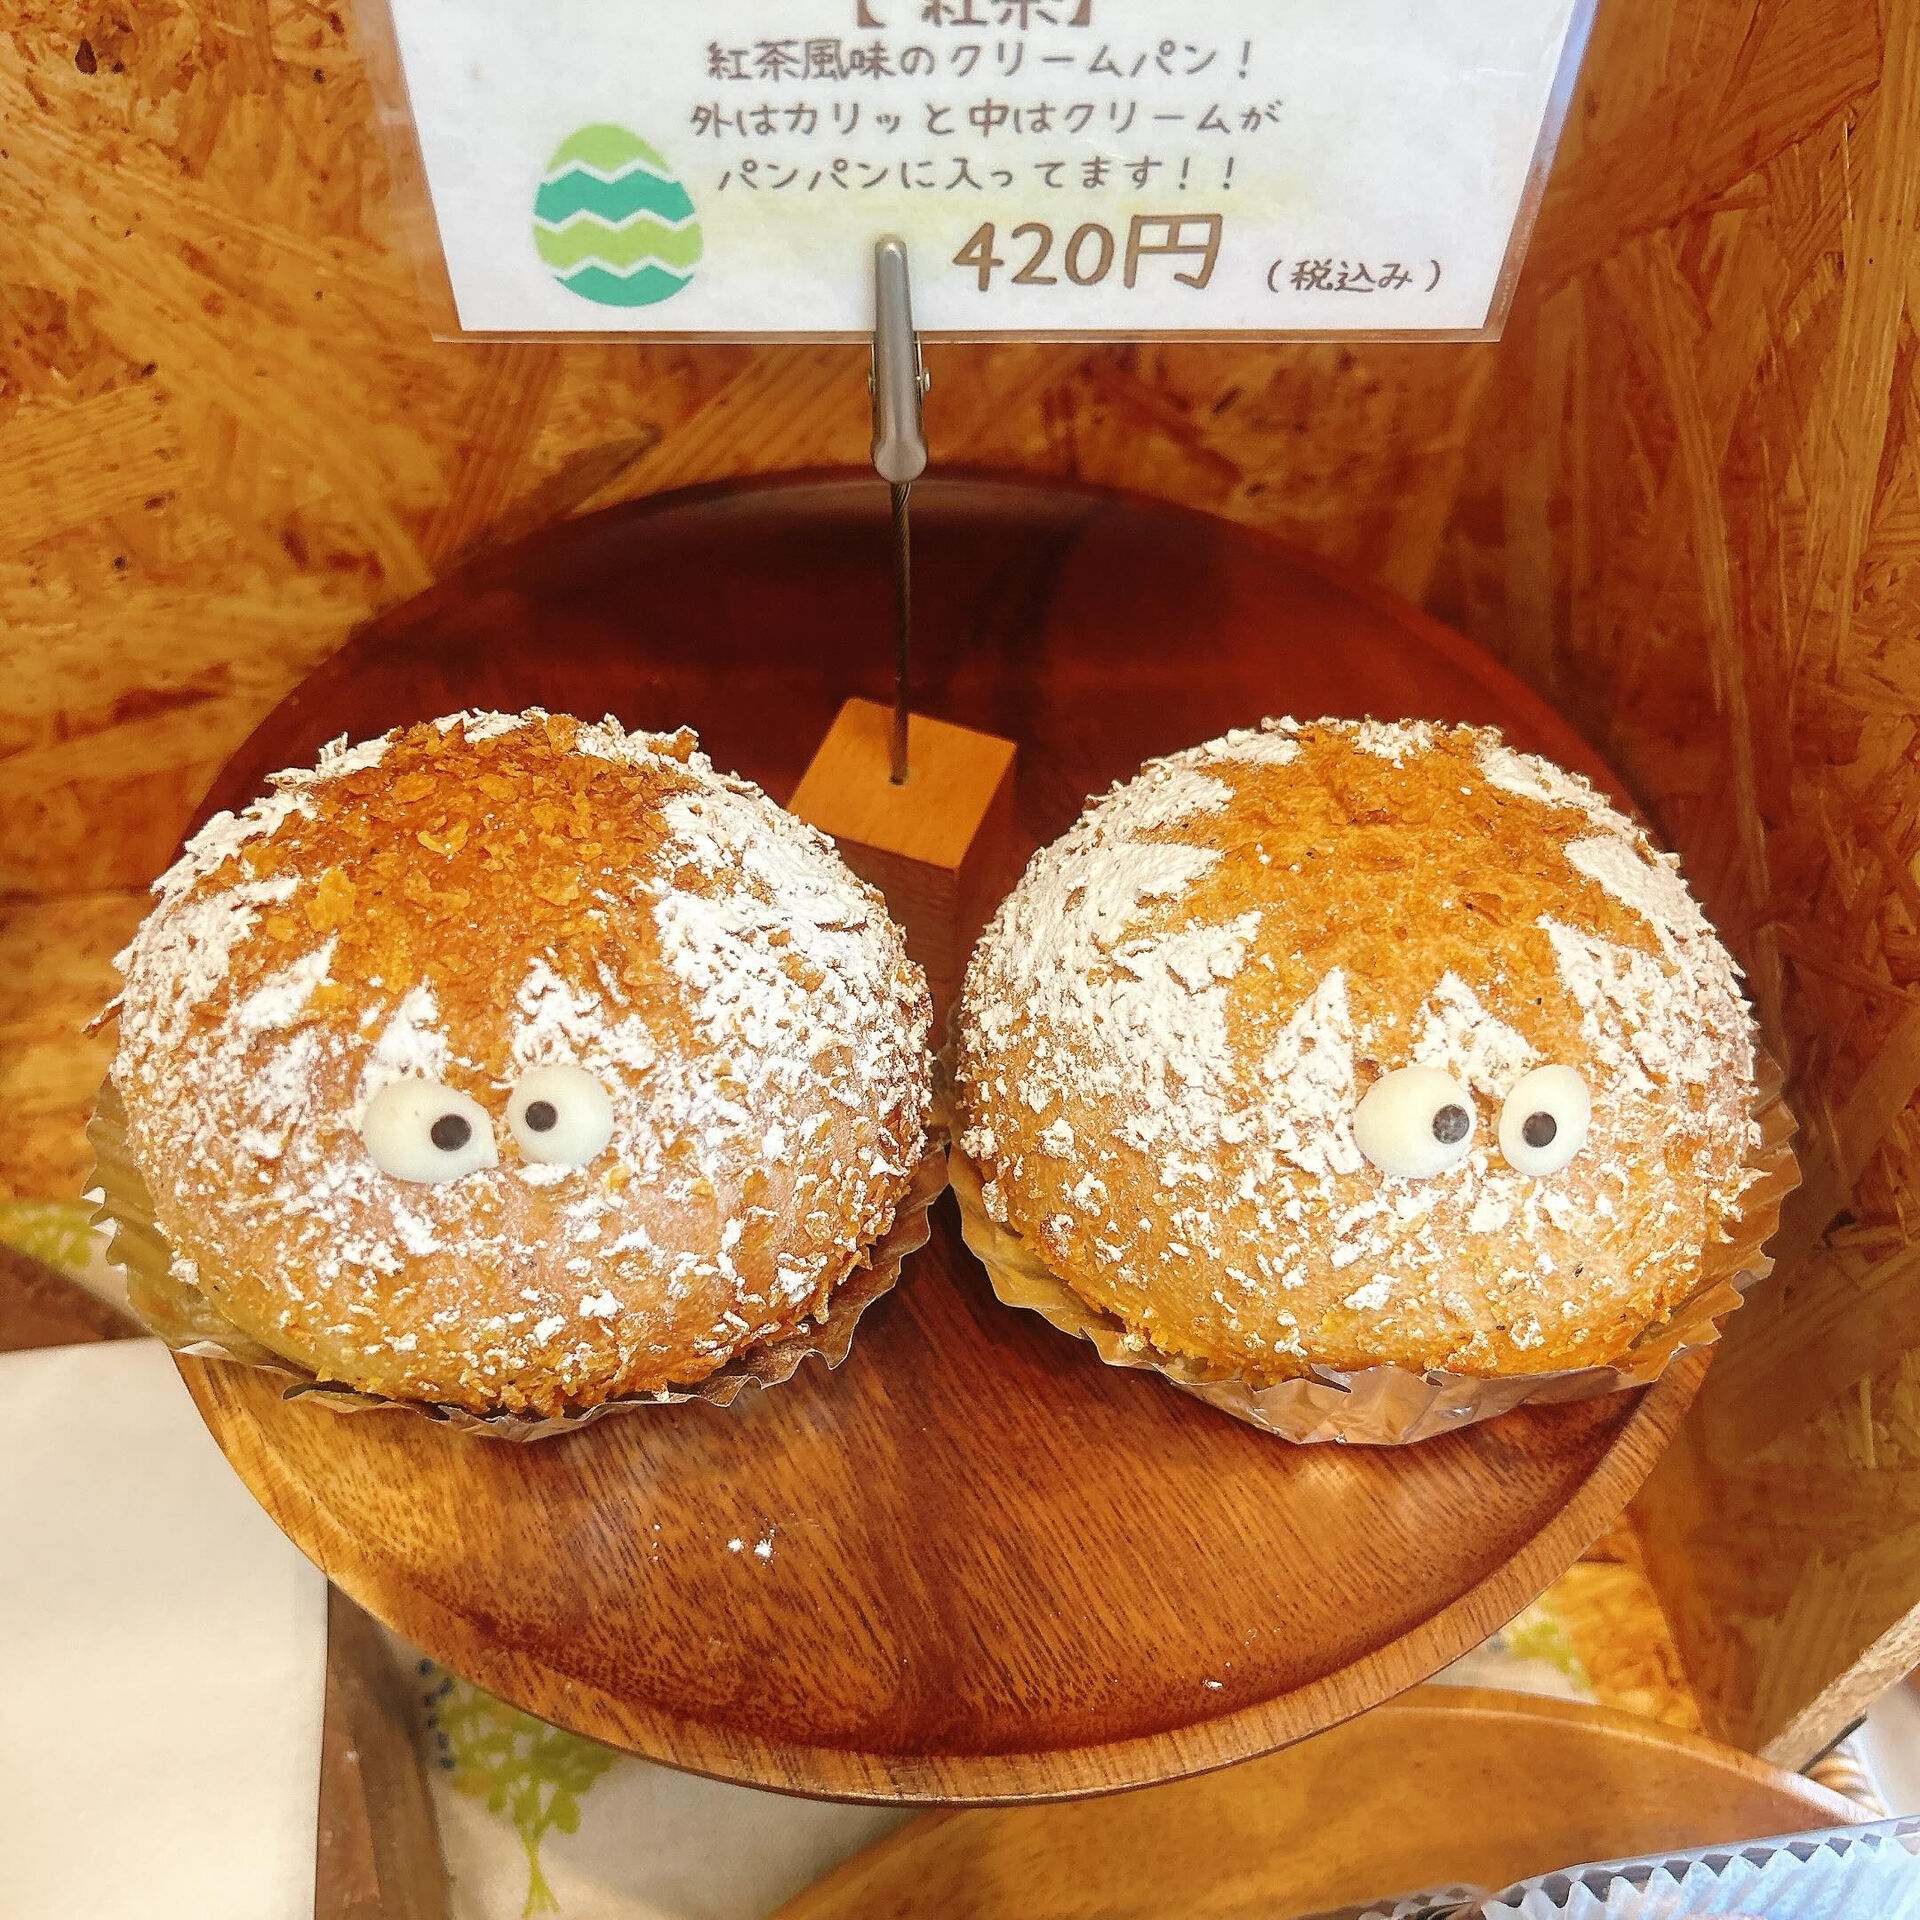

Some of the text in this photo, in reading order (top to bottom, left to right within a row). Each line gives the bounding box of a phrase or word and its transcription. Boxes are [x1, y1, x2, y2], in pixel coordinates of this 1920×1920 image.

[708, 39, 1254, 81] 紅茶風味のクリームパン！
[690, 99, 1282, 138] 外はカリッと中はクリームが
[717, 156, 1236, 192] パンパンに入ってます！！
[952, 213, 1441, 293] 420円 （税込み）
